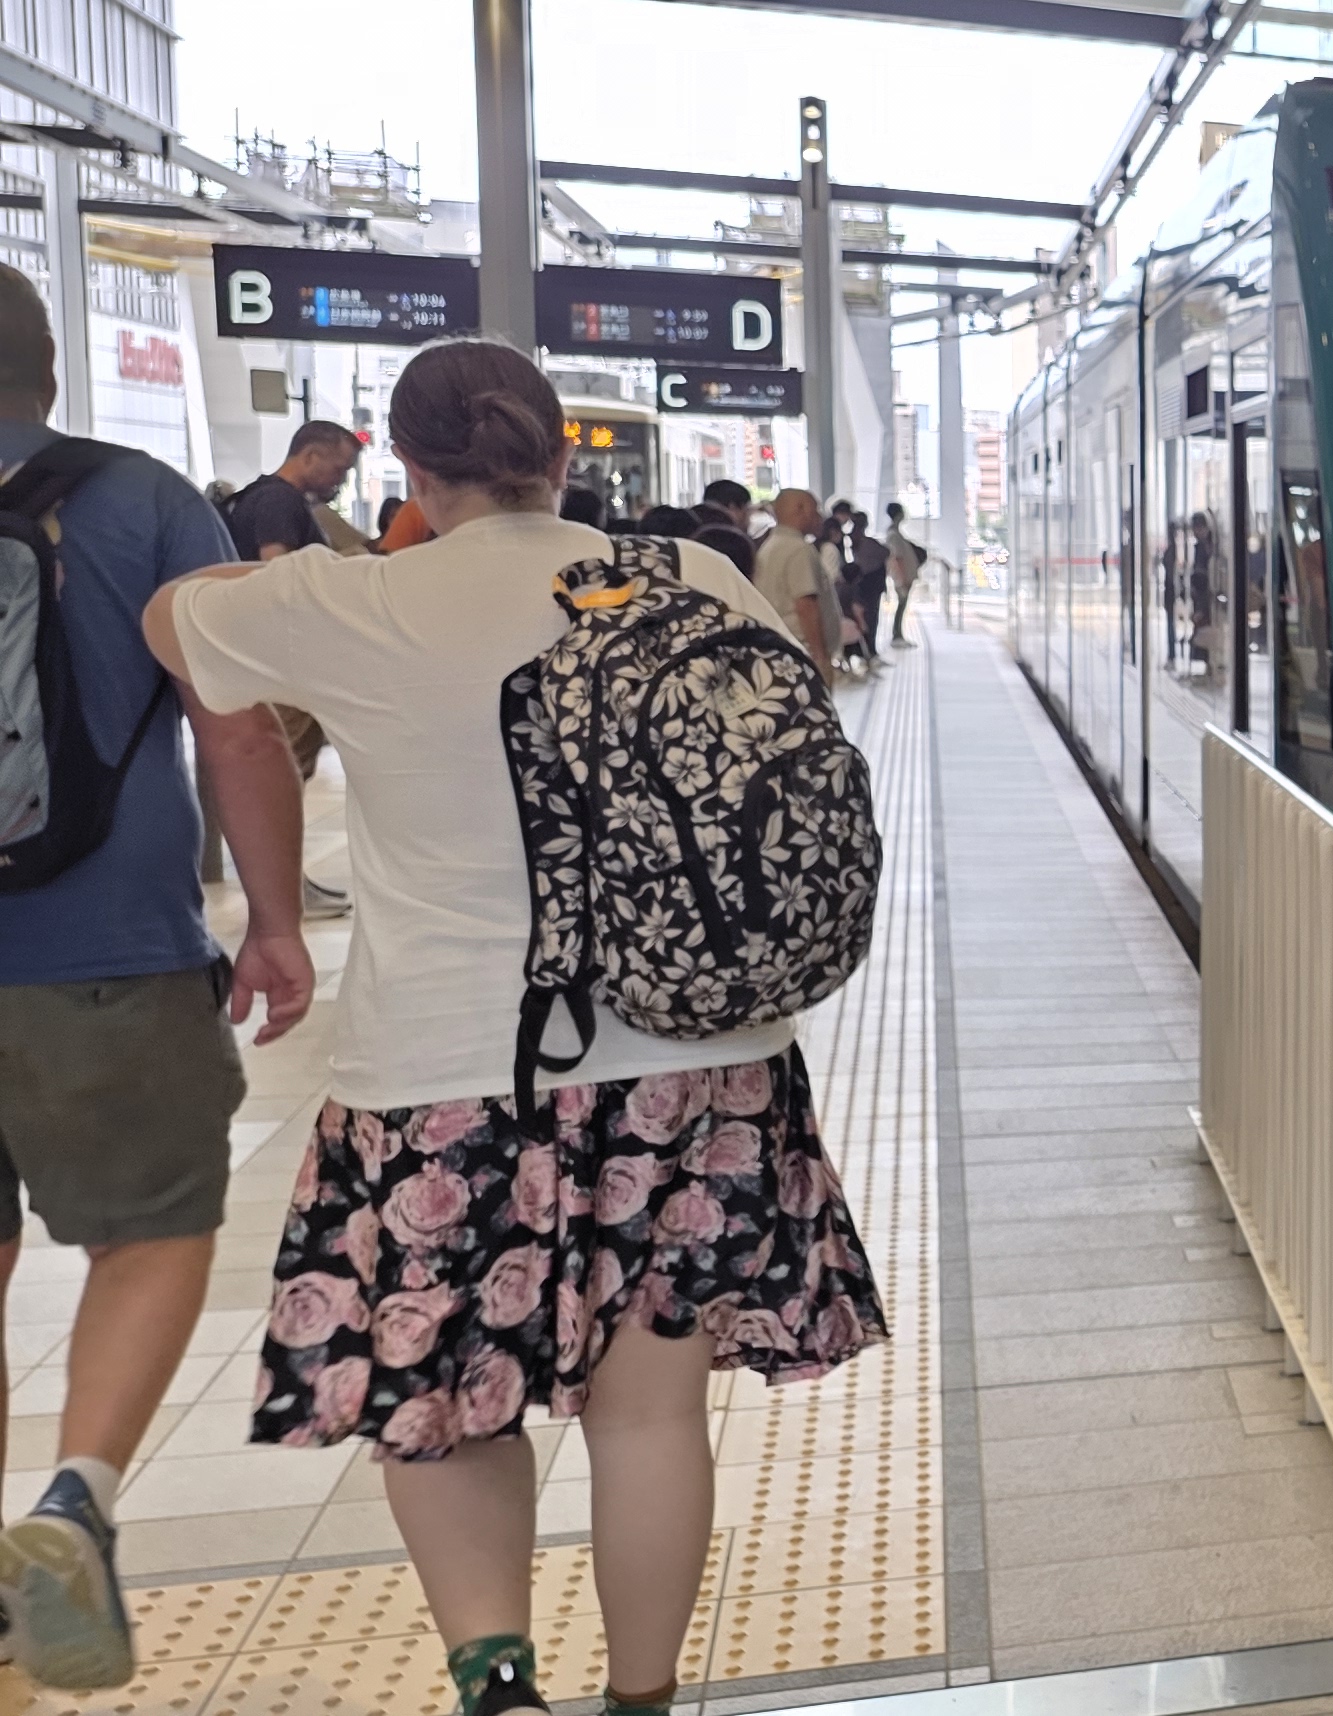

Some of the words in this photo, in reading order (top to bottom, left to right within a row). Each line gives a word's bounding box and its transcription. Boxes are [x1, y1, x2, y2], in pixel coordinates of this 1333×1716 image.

[228, 269, 274, 325] B
[731, 299, 773, 351] D
[661, 372, 689, 408] C
